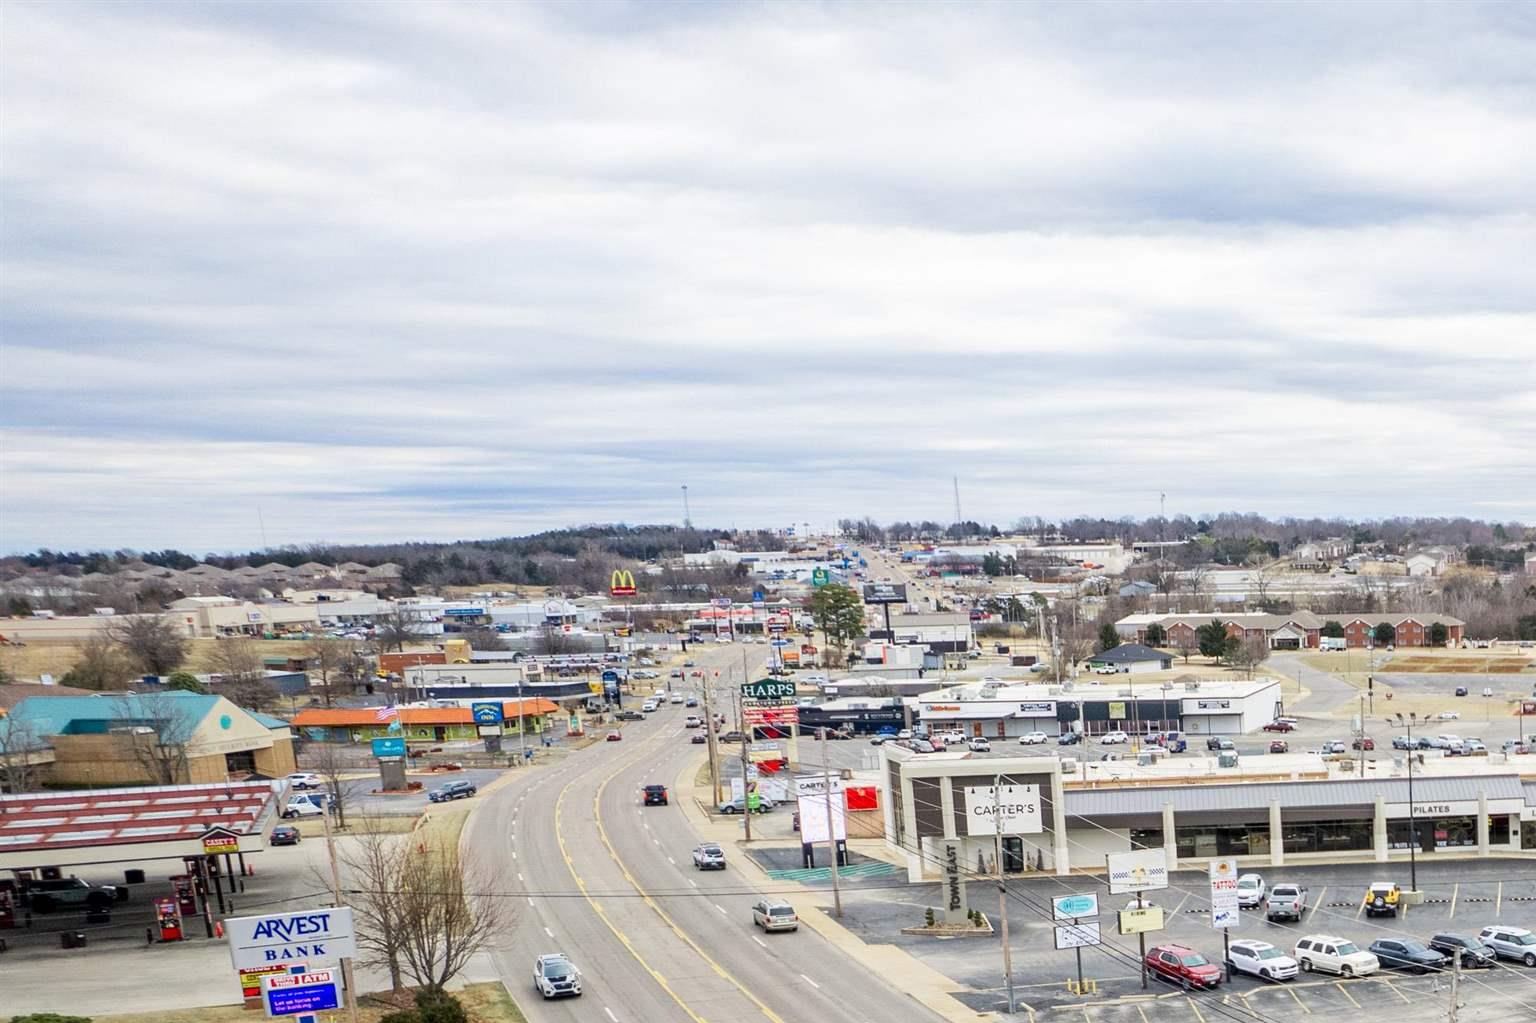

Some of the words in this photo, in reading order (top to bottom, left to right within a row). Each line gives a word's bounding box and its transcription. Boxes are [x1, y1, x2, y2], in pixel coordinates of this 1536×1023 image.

[743, 684, 794, 698] HARPS
[974, 804, 1035, 816] CARTER'S
[1414, 805, 1450, 814] PILATES
[946, 844, 957, 874] EAST
[1212, 880, 1237, 889] TATTOO
[950, 876, 961, 911] TOWN
[253, 914, 330, 941] ARVEST
[265, 944, 325, 961] BANK
[303, 973, 329, 984] ATM
